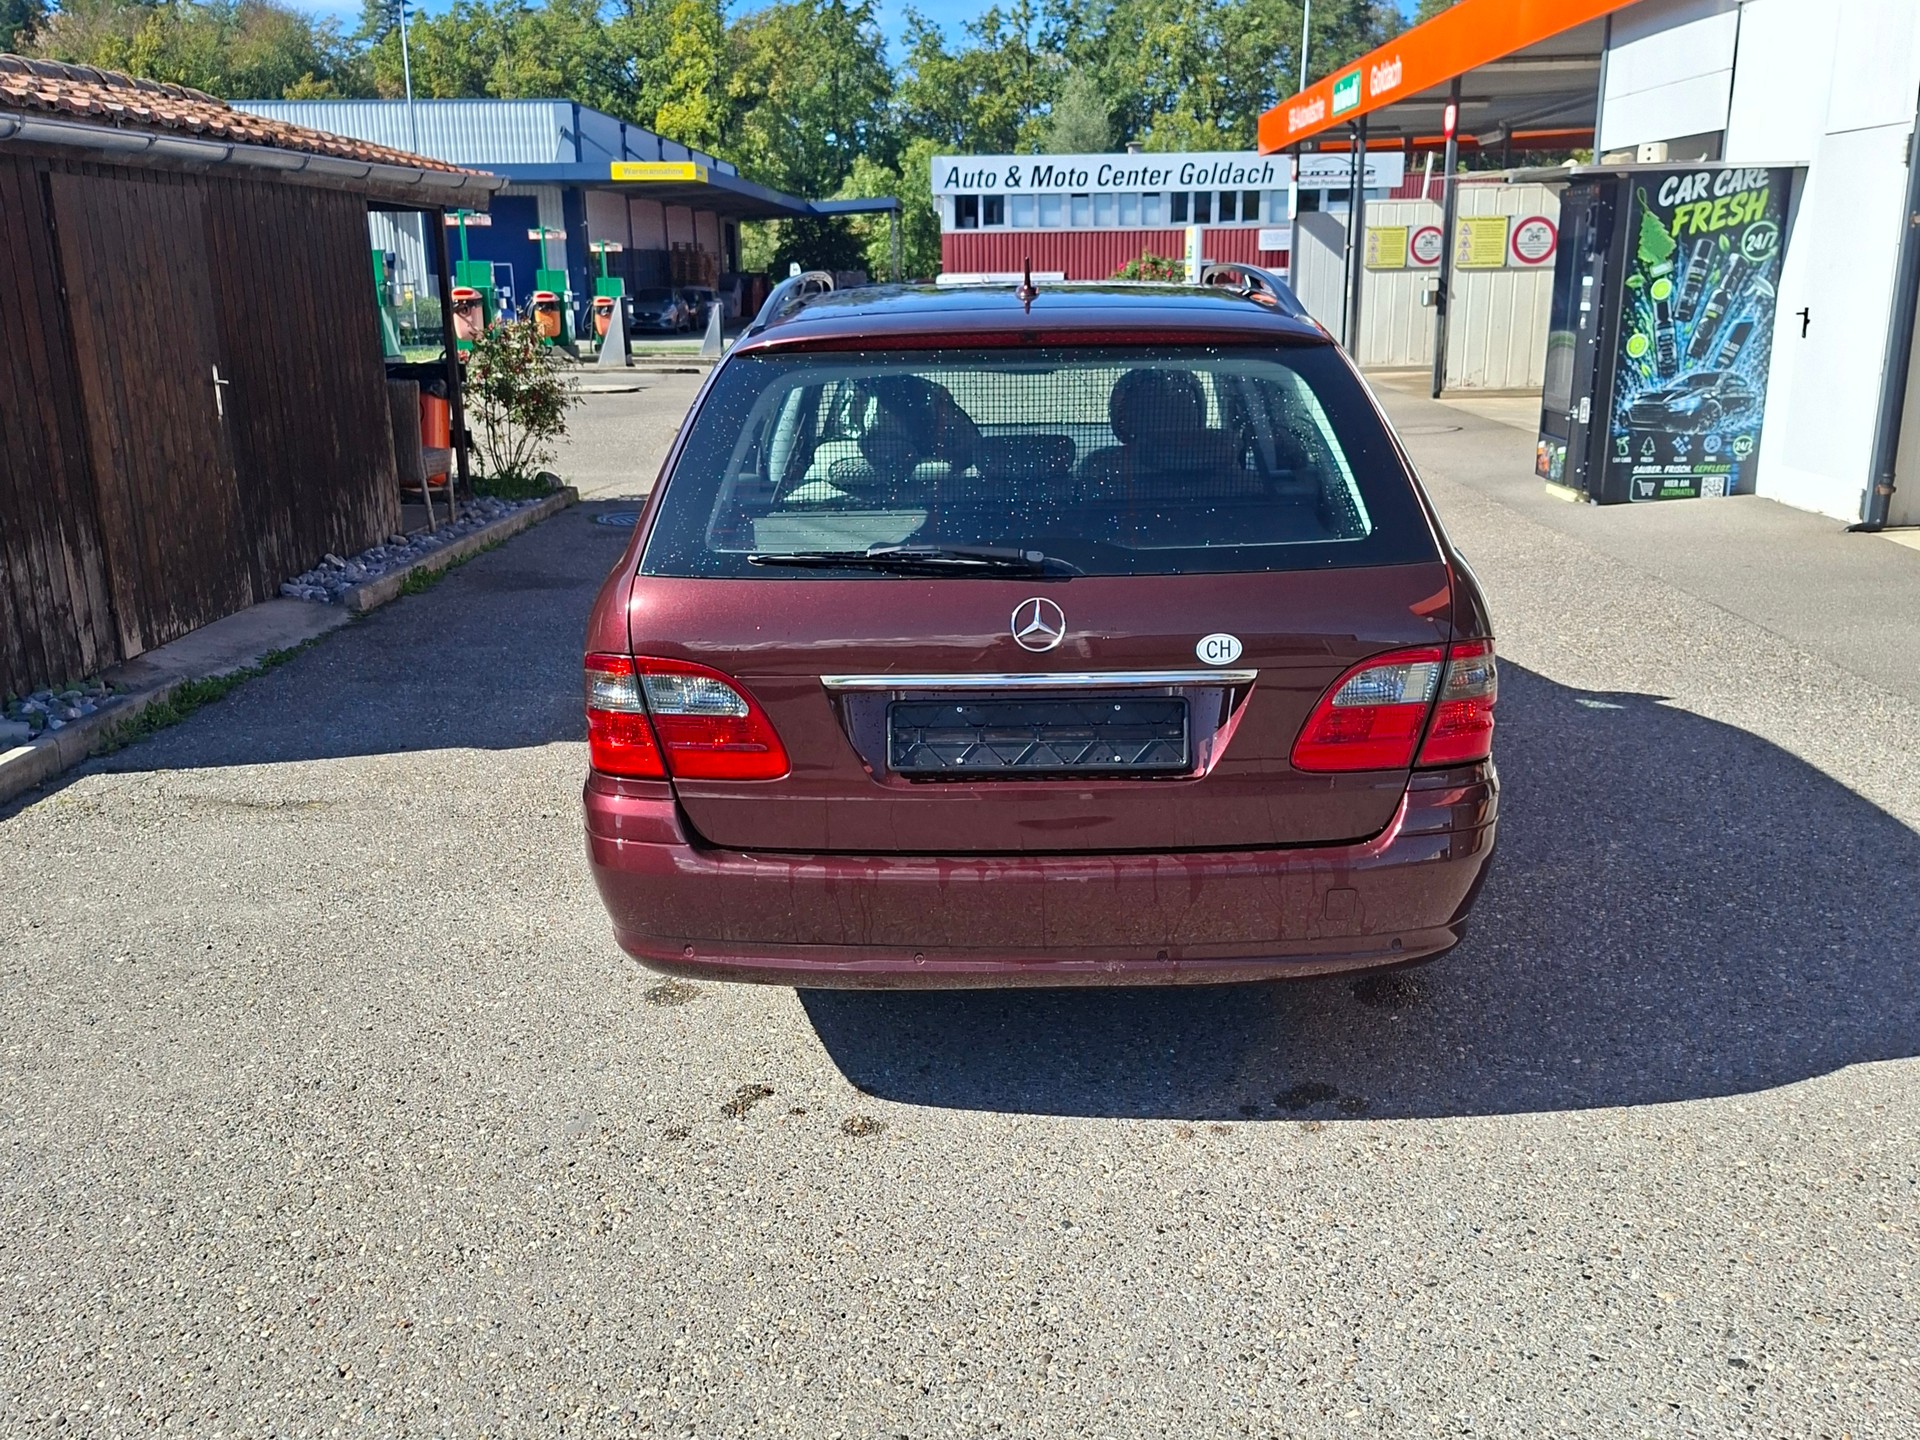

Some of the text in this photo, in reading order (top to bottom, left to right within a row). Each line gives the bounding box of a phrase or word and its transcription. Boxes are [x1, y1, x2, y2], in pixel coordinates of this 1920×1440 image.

[1370, 54, 1402, 97] Goldach
[623, 167, 684, 176] Warenannahme
[944, 161, 1275, 189] Auto & Moto Center Goldach
[1658, 168, 1770, 207] CAR CARE
[1671, 186, 1770, 238] FRESH
[1746, 231, 1778, 252] 24/7
[1735, 440, 1753, 452] 24/7
[1660, 488, 1696, 497] AUTOMATEN
[1206, 640, 1231, 659] CH
